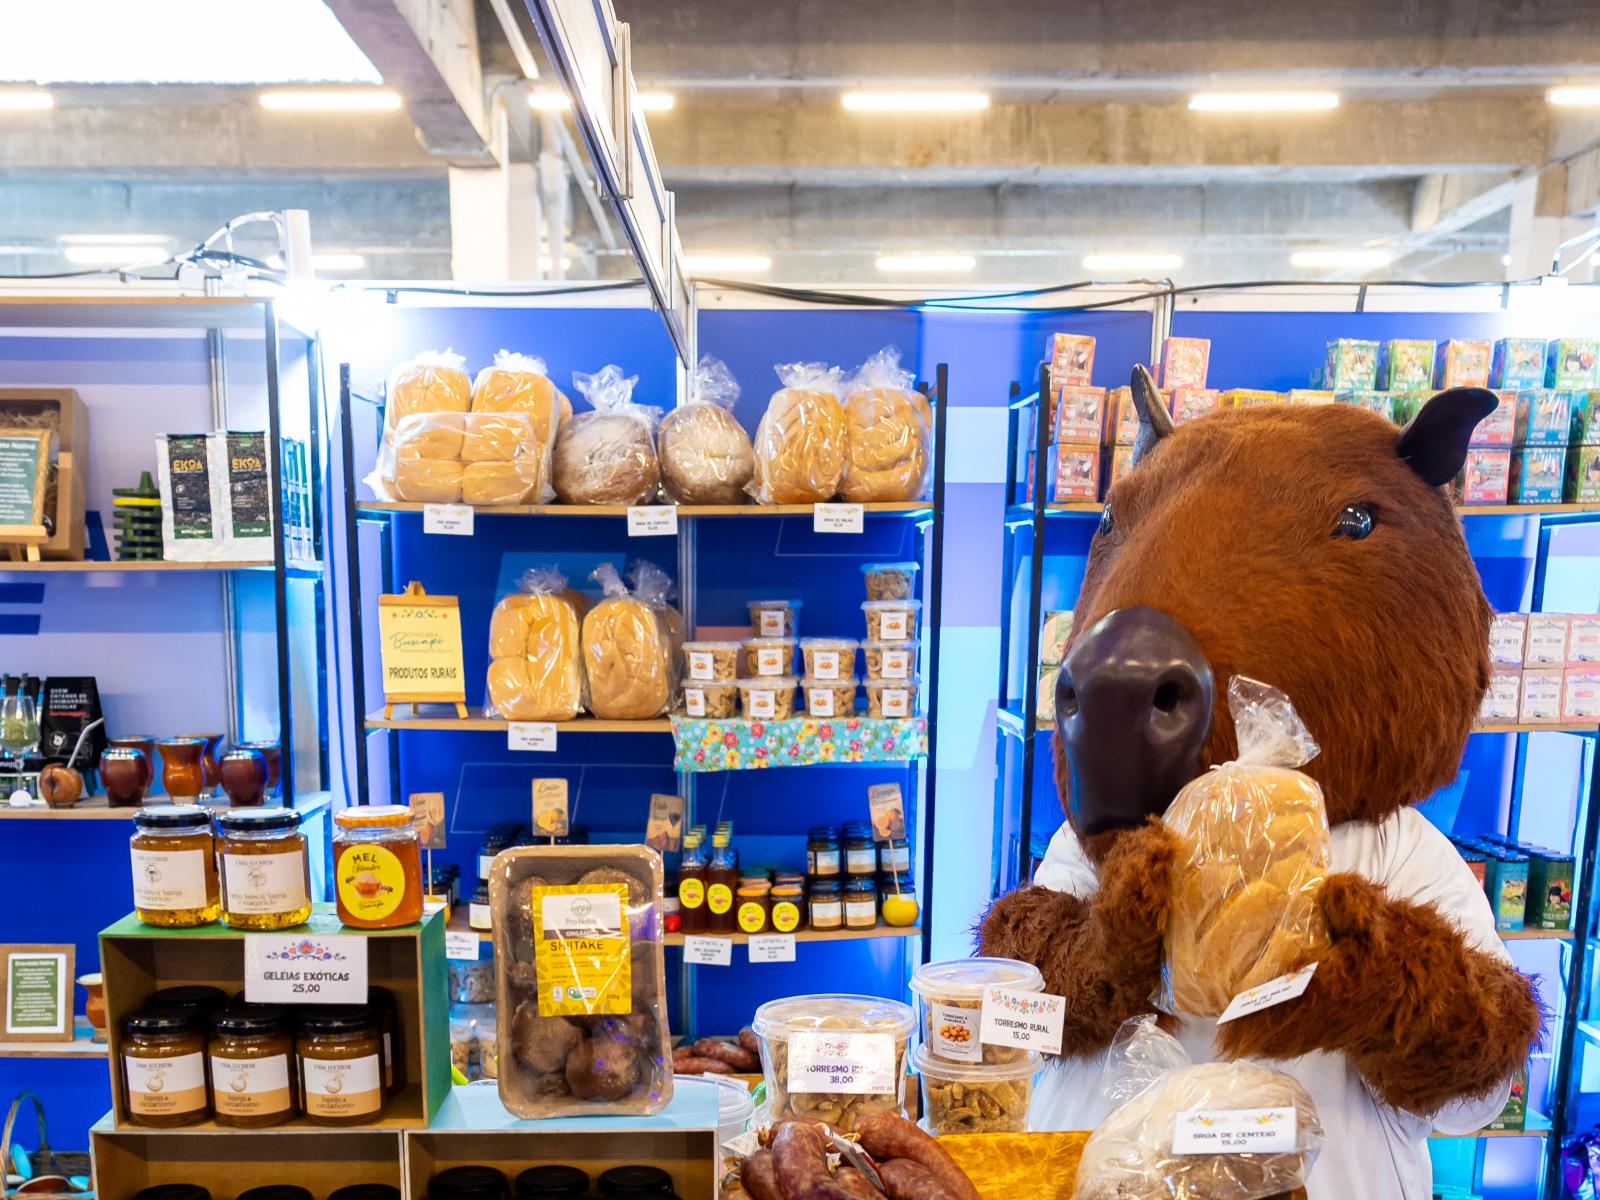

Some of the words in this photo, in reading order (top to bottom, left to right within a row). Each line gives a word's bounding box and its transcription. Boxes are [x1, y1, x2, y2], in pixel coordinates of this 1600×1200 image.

[231, 457, 262, 469] EKOA
[389, 667, 428, 679] PRODUTOS
[431, 667, 457, 679] RURAIS
[352, 853, 378, 864] MEL
[263, 969, 300, 981] GELÉIAS
[304, 969, 350, 981] EXÓTICAS
[292, 984, 321, 994] 25,00
[994, 1018, 1028, 1030] TORRESMO
[1029, 1023, 1050, 1034] RURAL
[1012, 1031, 1030, 1041] 15,00
[830, 1075, 854, 1084] 38,00
